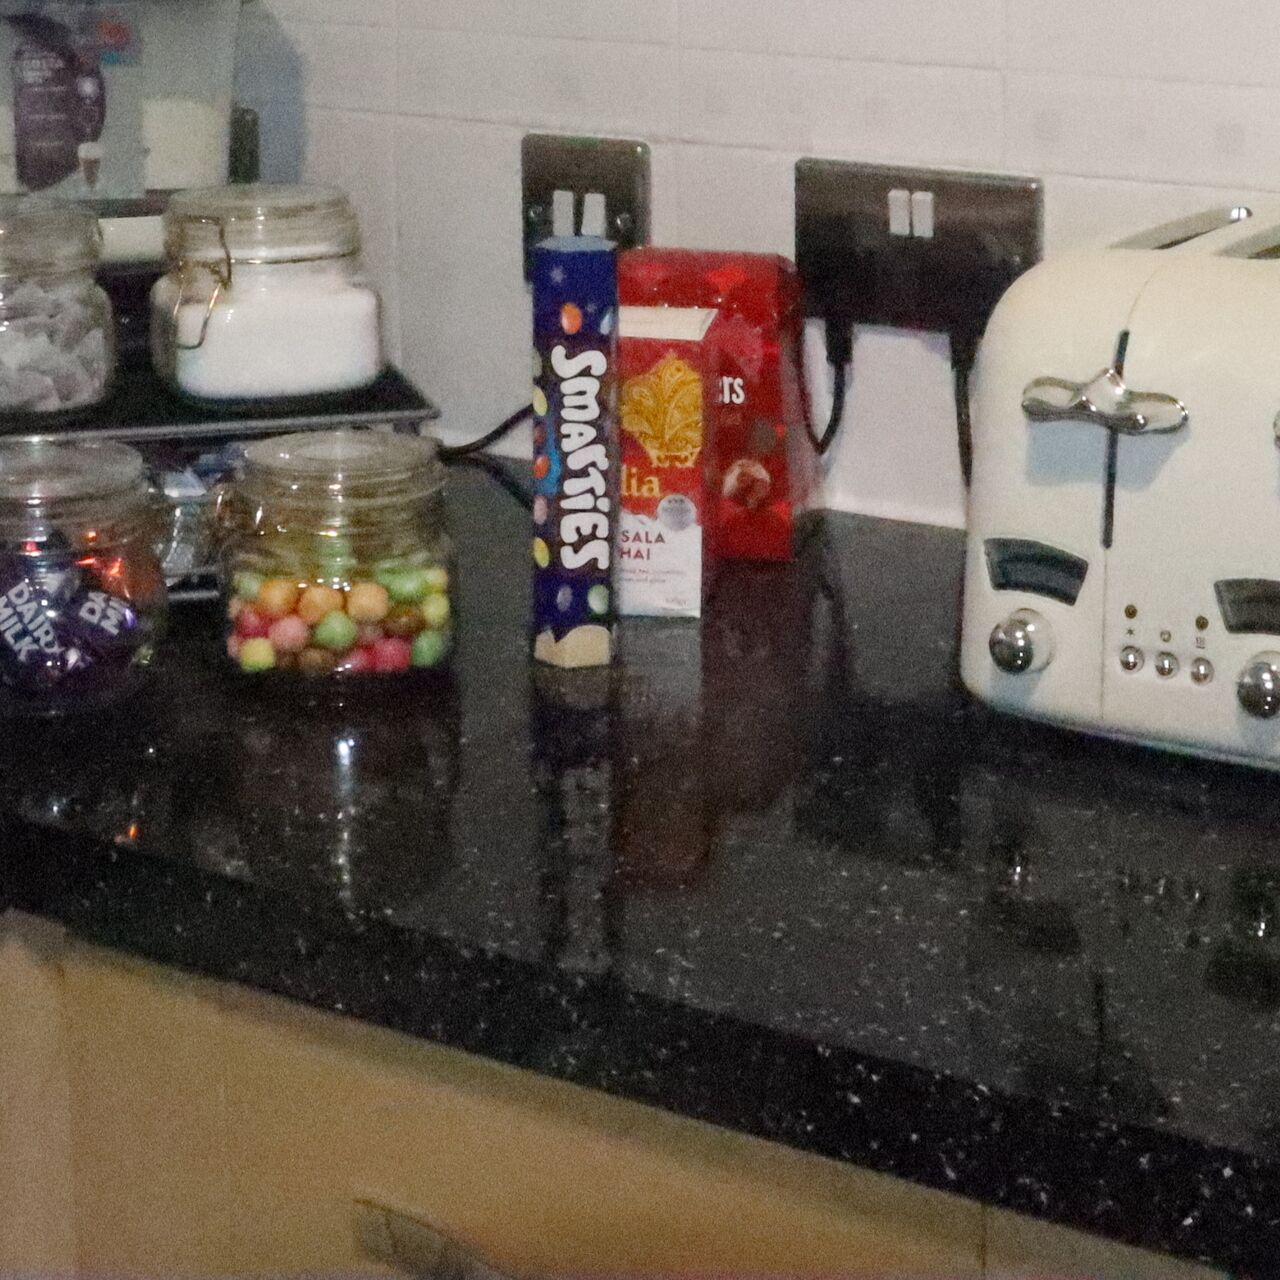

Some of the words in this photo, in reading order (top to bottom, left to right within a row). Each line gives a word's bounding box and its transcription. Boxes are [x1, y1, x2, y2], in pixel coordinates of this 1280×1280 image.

[620, 530, 666, 545] SALA
[619, 548, 651, 561] HAI
[8, 581, 66, 655] DAIRY
